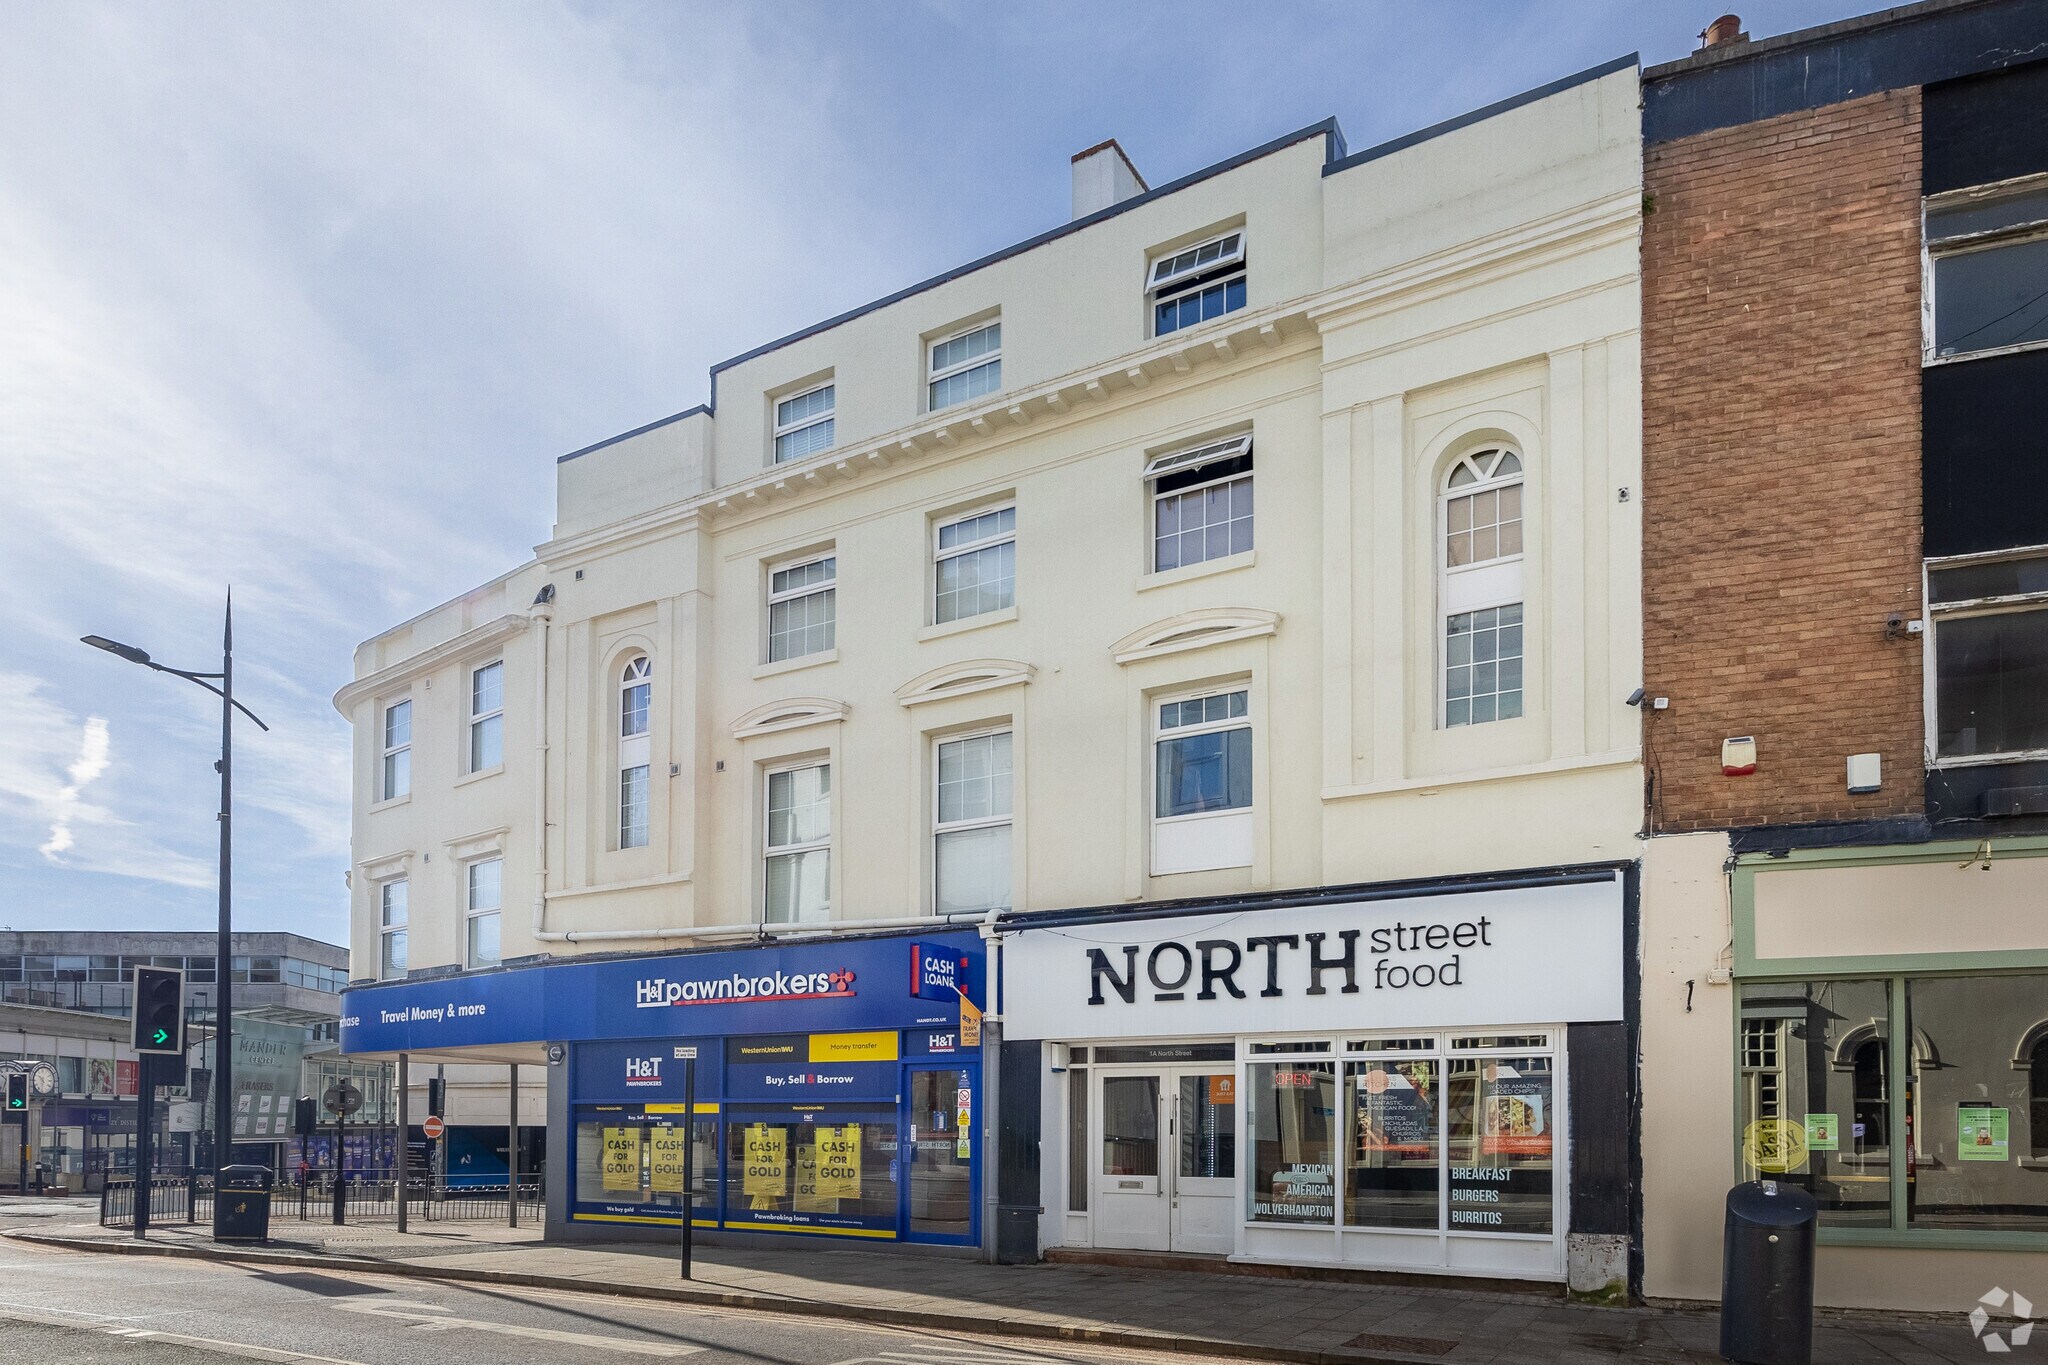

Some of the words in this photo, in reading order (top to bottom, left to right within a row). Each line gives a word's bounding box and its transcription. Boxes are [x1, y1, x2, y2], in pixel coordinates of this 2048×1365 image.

[1371, 916, 1491, 953] street
[925, 957, 954, 975] CASH
[1086, 929, 1361, 1005] NORTH
[1375, 955, 1463, 989] food
[925, 972, 955, 987] LOANS
[381, 1006, 409, 1023] Travel
[411, 1007, 444, 1022] Money
[447, 1003, 455, 1017] &
[458, 1003, 486, 1016] more
[929, 1034, 955, 1047] H&T
[626, 1057, 662, 1077] H&T
[765, 1075, 786, 1086] Buy,
[788, 1075, 805, 1084] Sell
[807, 1074, 815, 1084] &
[817, 1074, 854, 1084] Borrow
[1275, 1073, 1312, 1085] OPEN
[608, 1140, 635, 1150] CASH
[655, 1140, 684, 1150] CASH
[749, 1142, 781, 1152] CASH
[821, 1142, 855, 1152] CASH
[661, 1153, 678, 1161] FOR
[756, 1155, 774, 1163] FOR
[828, 1156, 848, 1164] FOR
[607, 1163, 635, 1173] GOLD
[655, 1164, 684, 1174] GOLD
[802, 1160, 816, 1169] CA
[1292, 1164, 1333, 1175] MEXICAN
[748, 1166, 781, 1177] GOLD
[820, 1168, 855, 1178] GOLD
[1452, 1168, 1512, 1181] BREAKFAST
[1287, 1184, 1333, 1196] AMERICAN
[1452, 1189, 1499, 1202] BURGERS
[1254, 1203, 1333, 1217] WOLVERHAMPTON
[754, 1213, 793, 1222] Pawnbroking
[1452, 1211, 1502, 1224] BURRITOS
